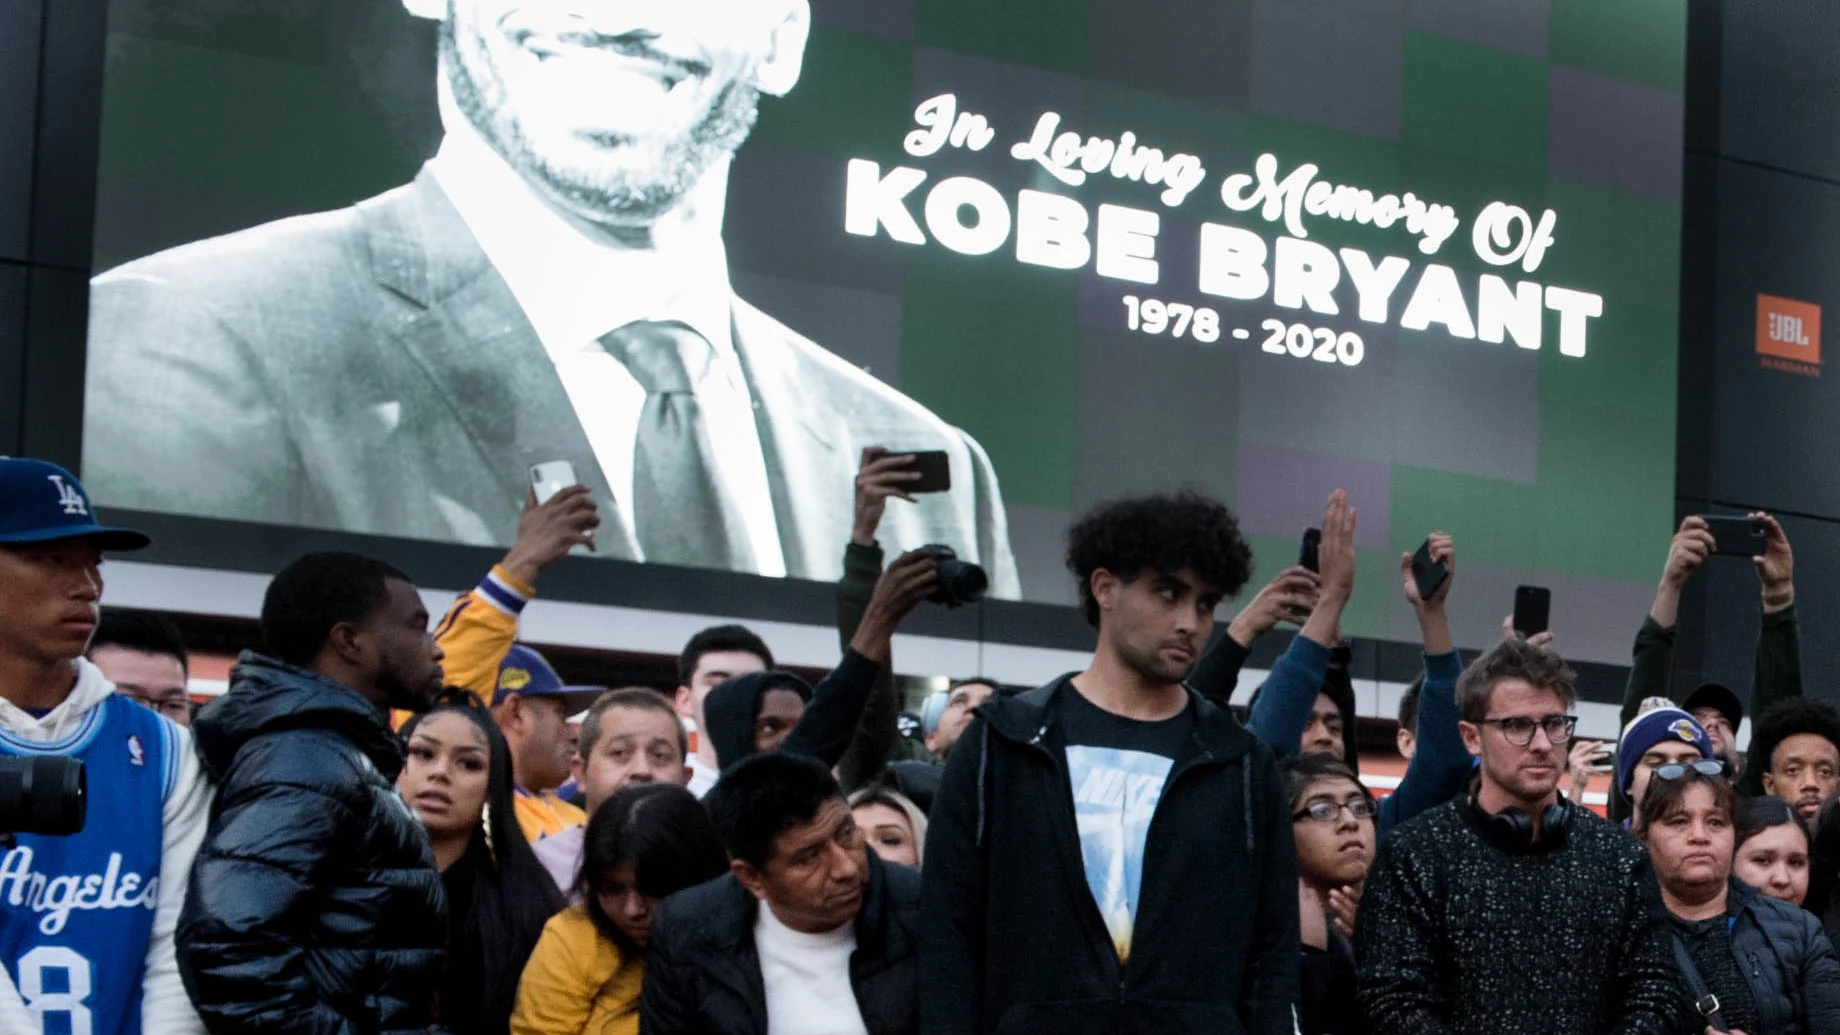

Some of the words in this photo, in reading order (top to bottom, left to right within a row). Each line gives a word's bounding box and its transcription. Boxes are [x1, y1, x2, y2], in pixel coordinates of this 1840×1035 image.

[903, 93, 994, 157] In
[1010, 112, 1206, 207] Loving
[1221, 153, 1459, 255] Memory
[1472, 201, 1556, 273] Of
[845, 158, 1160, 284] KOBE
[1199, 222, 1603, 358] BRYANT
[1122, 295, 1220, 343] 1978
[1261, 318, 1364, 366] 2020
[1768, 311, 1809, 346] JBL
[47, 474, 88, 516] LA
